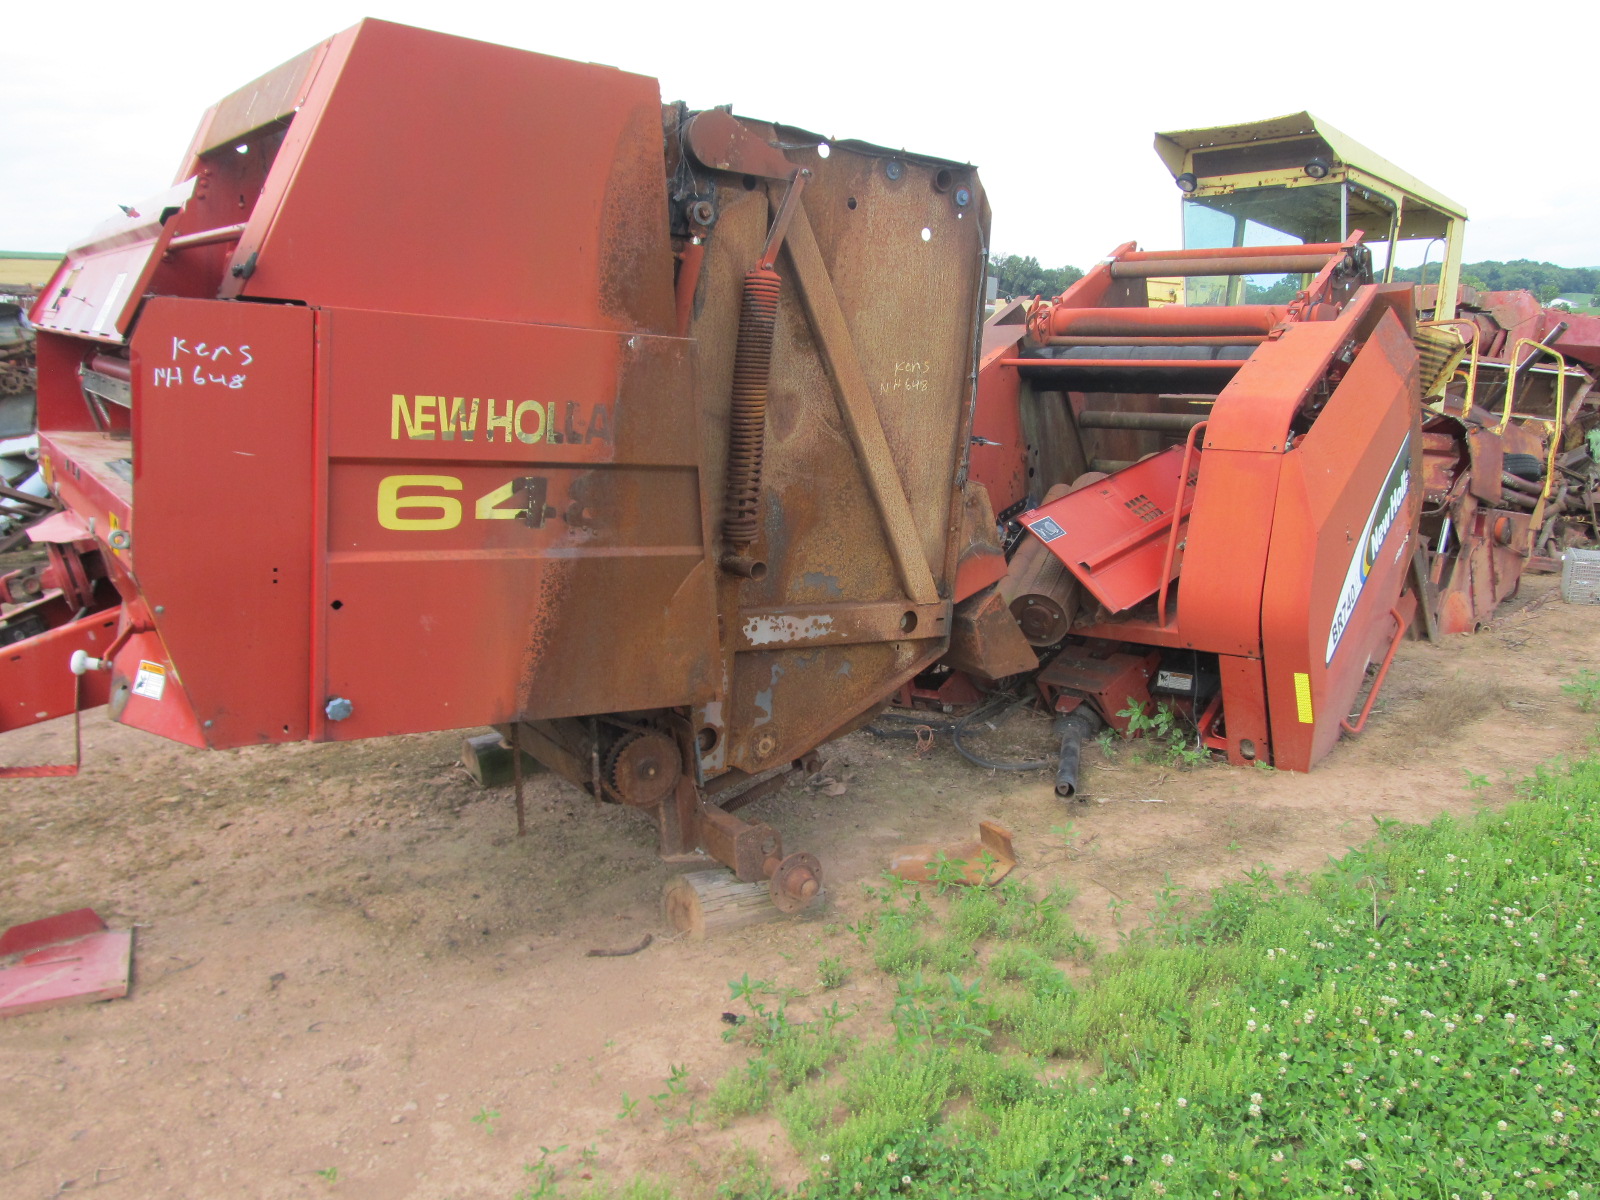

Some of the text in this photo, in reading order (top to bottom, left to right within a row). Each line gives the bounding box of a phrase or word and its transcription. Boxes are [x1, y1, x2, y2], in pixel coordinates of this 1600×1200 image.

[173, 336, 253, 366] Kens
[154, 366, 183, 388] NH
[391, 394, 480, 442] NEW
[1370, 507, 1391, 561] New
